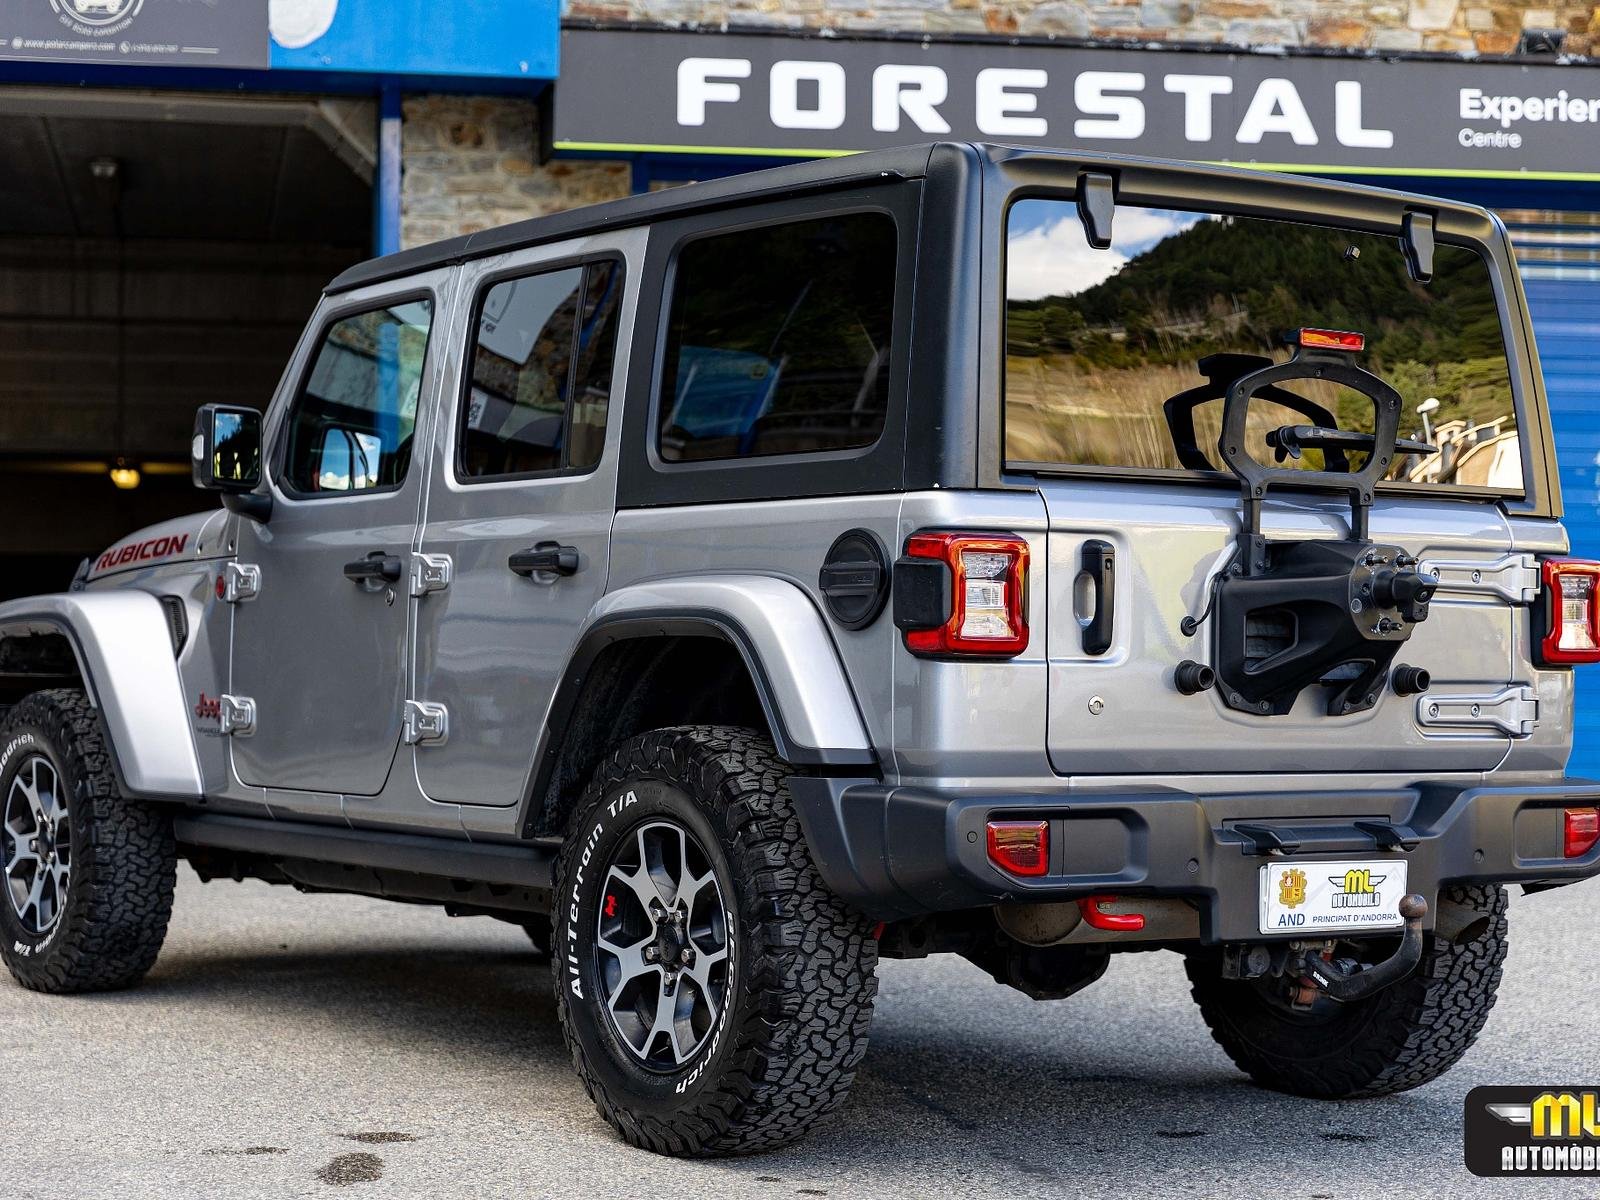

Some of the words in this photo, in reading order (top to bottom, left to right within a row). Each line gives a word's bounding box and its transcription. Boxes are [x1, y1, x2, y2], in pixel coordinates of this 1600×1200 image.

[677, 57, 1393, 148] FORESTAL
[1458, 127, 1522, 148] Centre
[95, 534, 189, 571] RUBICON
[567, 822, 604, 1001] All-Terrain
[606, 790, 638, 818] T/A
[1344, 869, 1375, 894] ML
[1278, 913, 1306, 927] AND
[1312, 914, 1352, 923] PRINCIPAT
[1353, 913, 1398, 922] D'ANDORRA
[675, 910, 736, 1095] BFGoodrich
